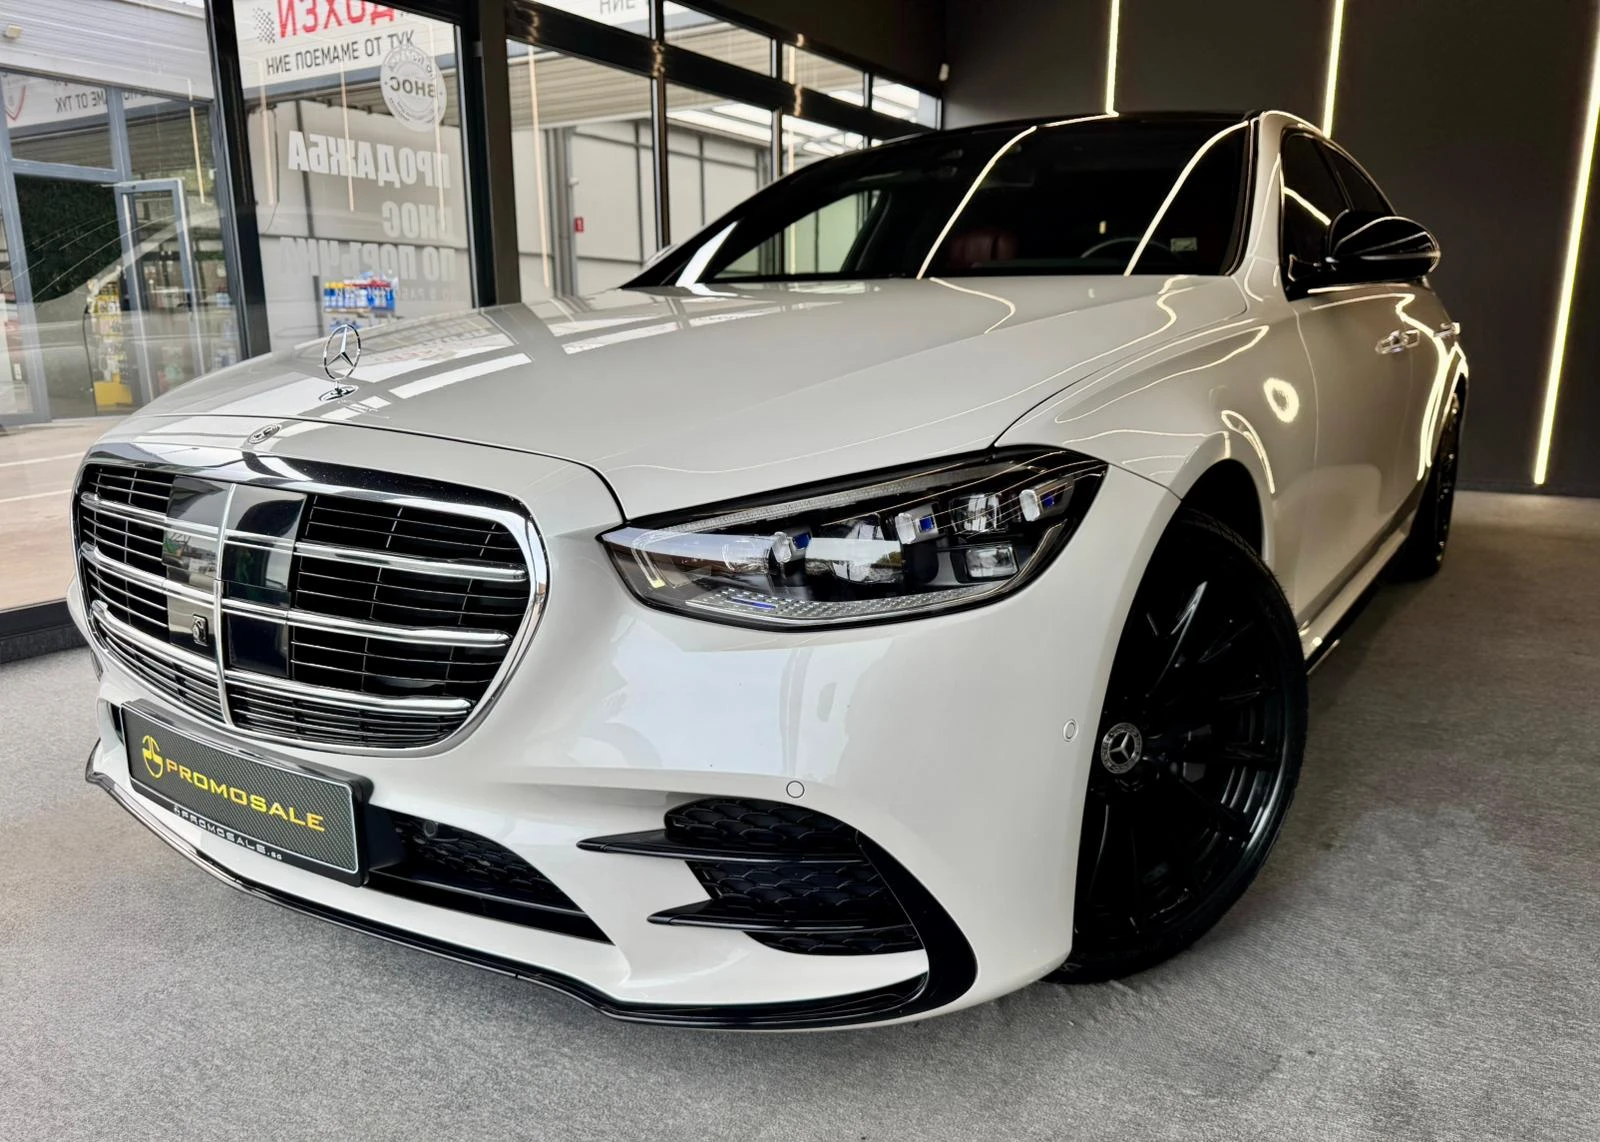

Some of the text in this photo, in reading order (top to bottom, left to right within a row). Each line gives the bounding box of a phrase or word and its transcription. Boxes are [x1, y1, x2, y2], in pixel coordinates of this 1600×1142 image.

[266, 54, 292, 76] НИЕ
[295, 41, 359, 70] ПОЕМАМЕ
[364, 36, 382, 57] ОТ
[388, 29, 416, 51] ТУК
[166, 759, 326, 832] PROMOSALE
